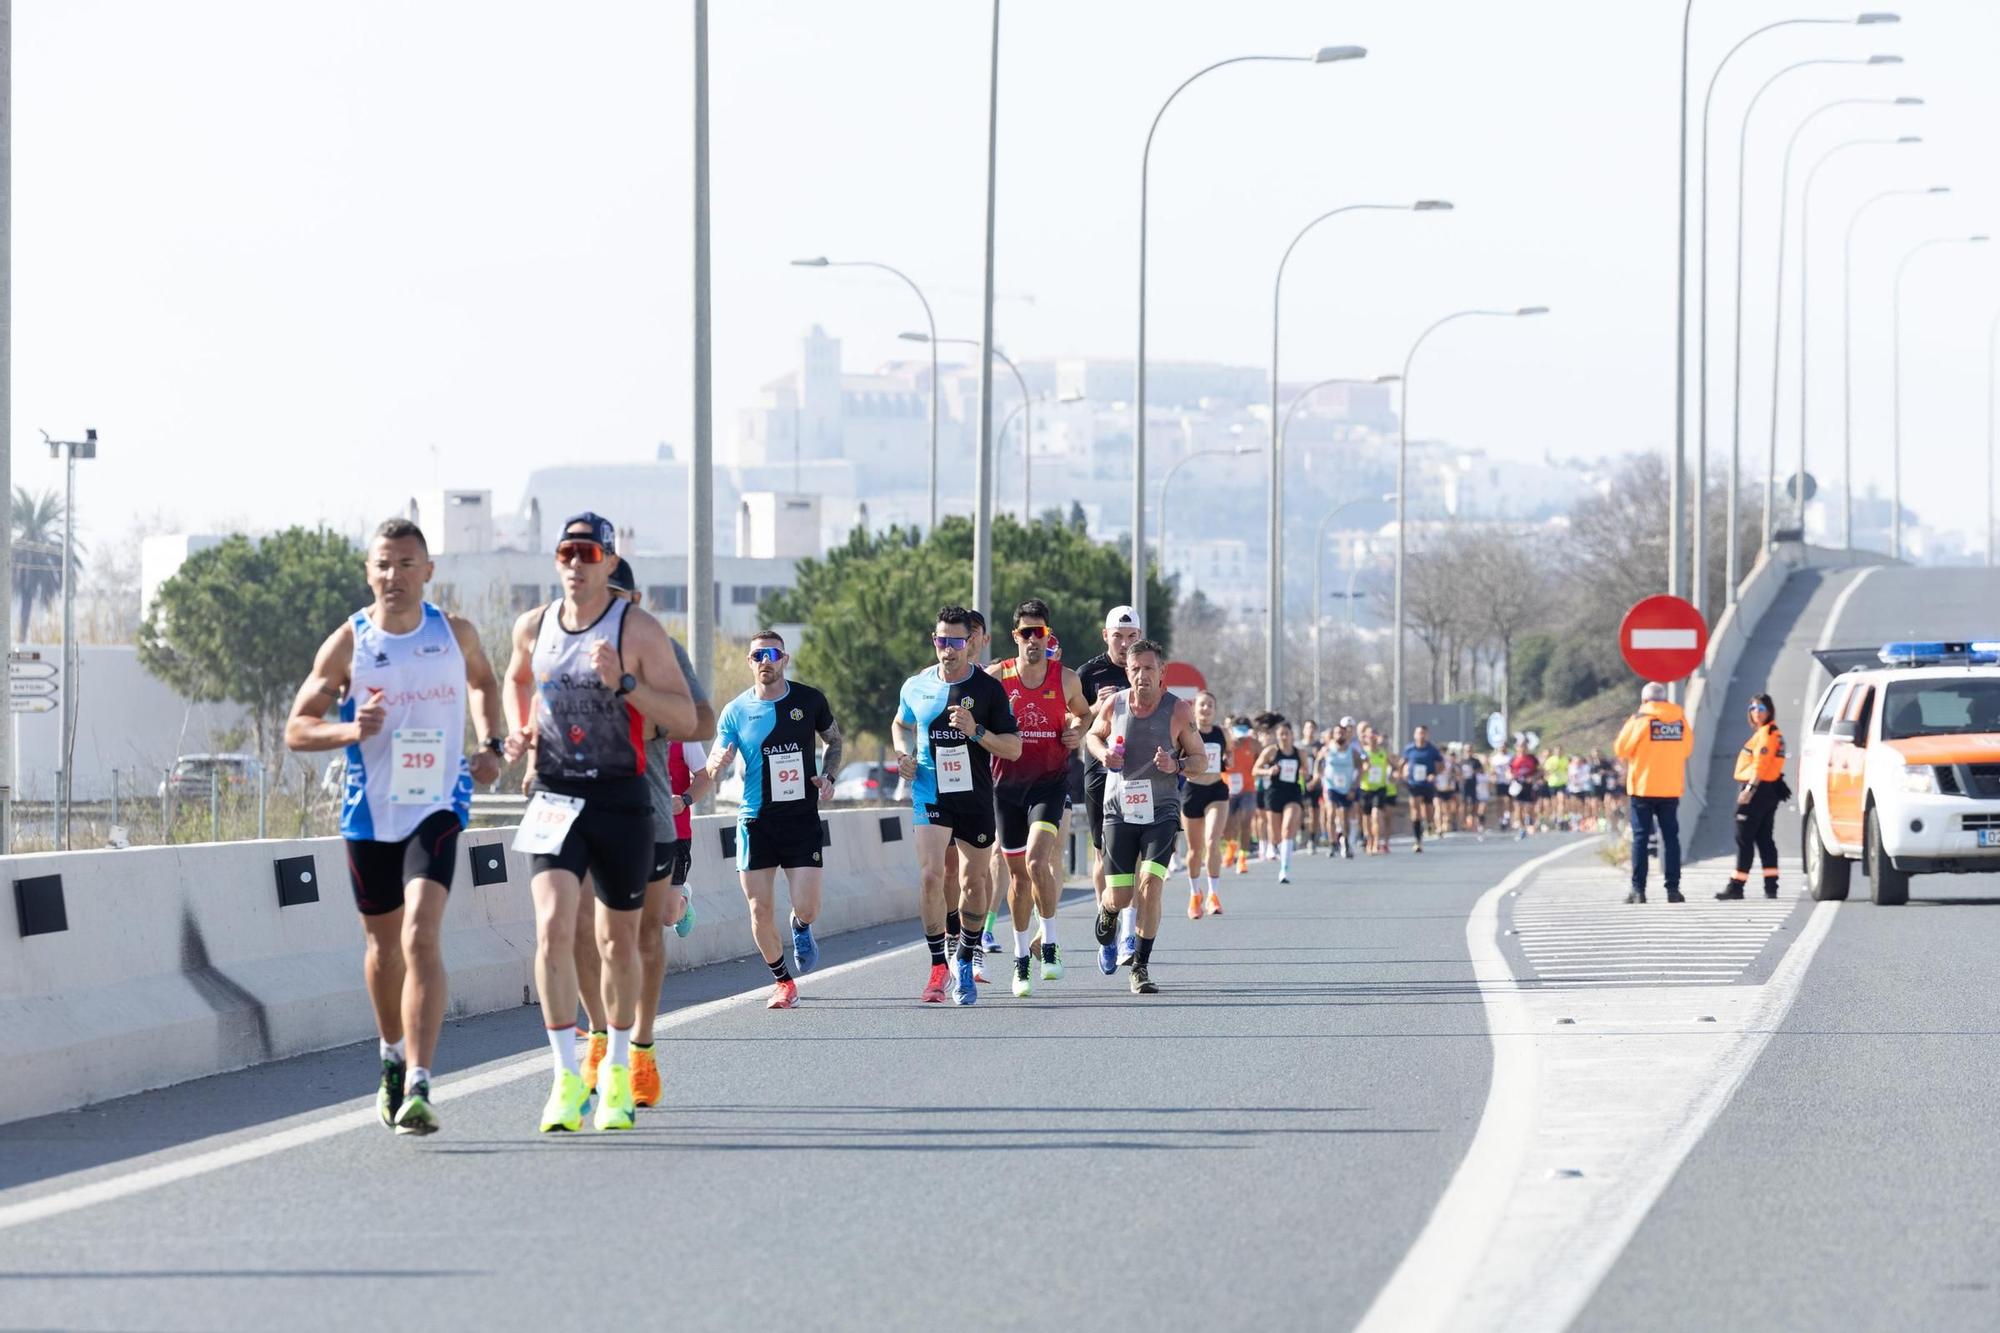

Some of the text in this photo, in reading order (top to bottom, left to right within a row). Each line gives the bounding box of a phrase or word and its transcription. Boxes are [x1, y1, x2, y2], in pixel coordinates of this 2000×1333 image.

[929, 729, 966, 740] JESÚS
[762, 742, 800, 756] SALVA
[402, 752, 436, 769] 219
[942, 761, 962, 771] 115
[778, 769, 800, 783] 92
[1125, 793, 1149, 804] 282
